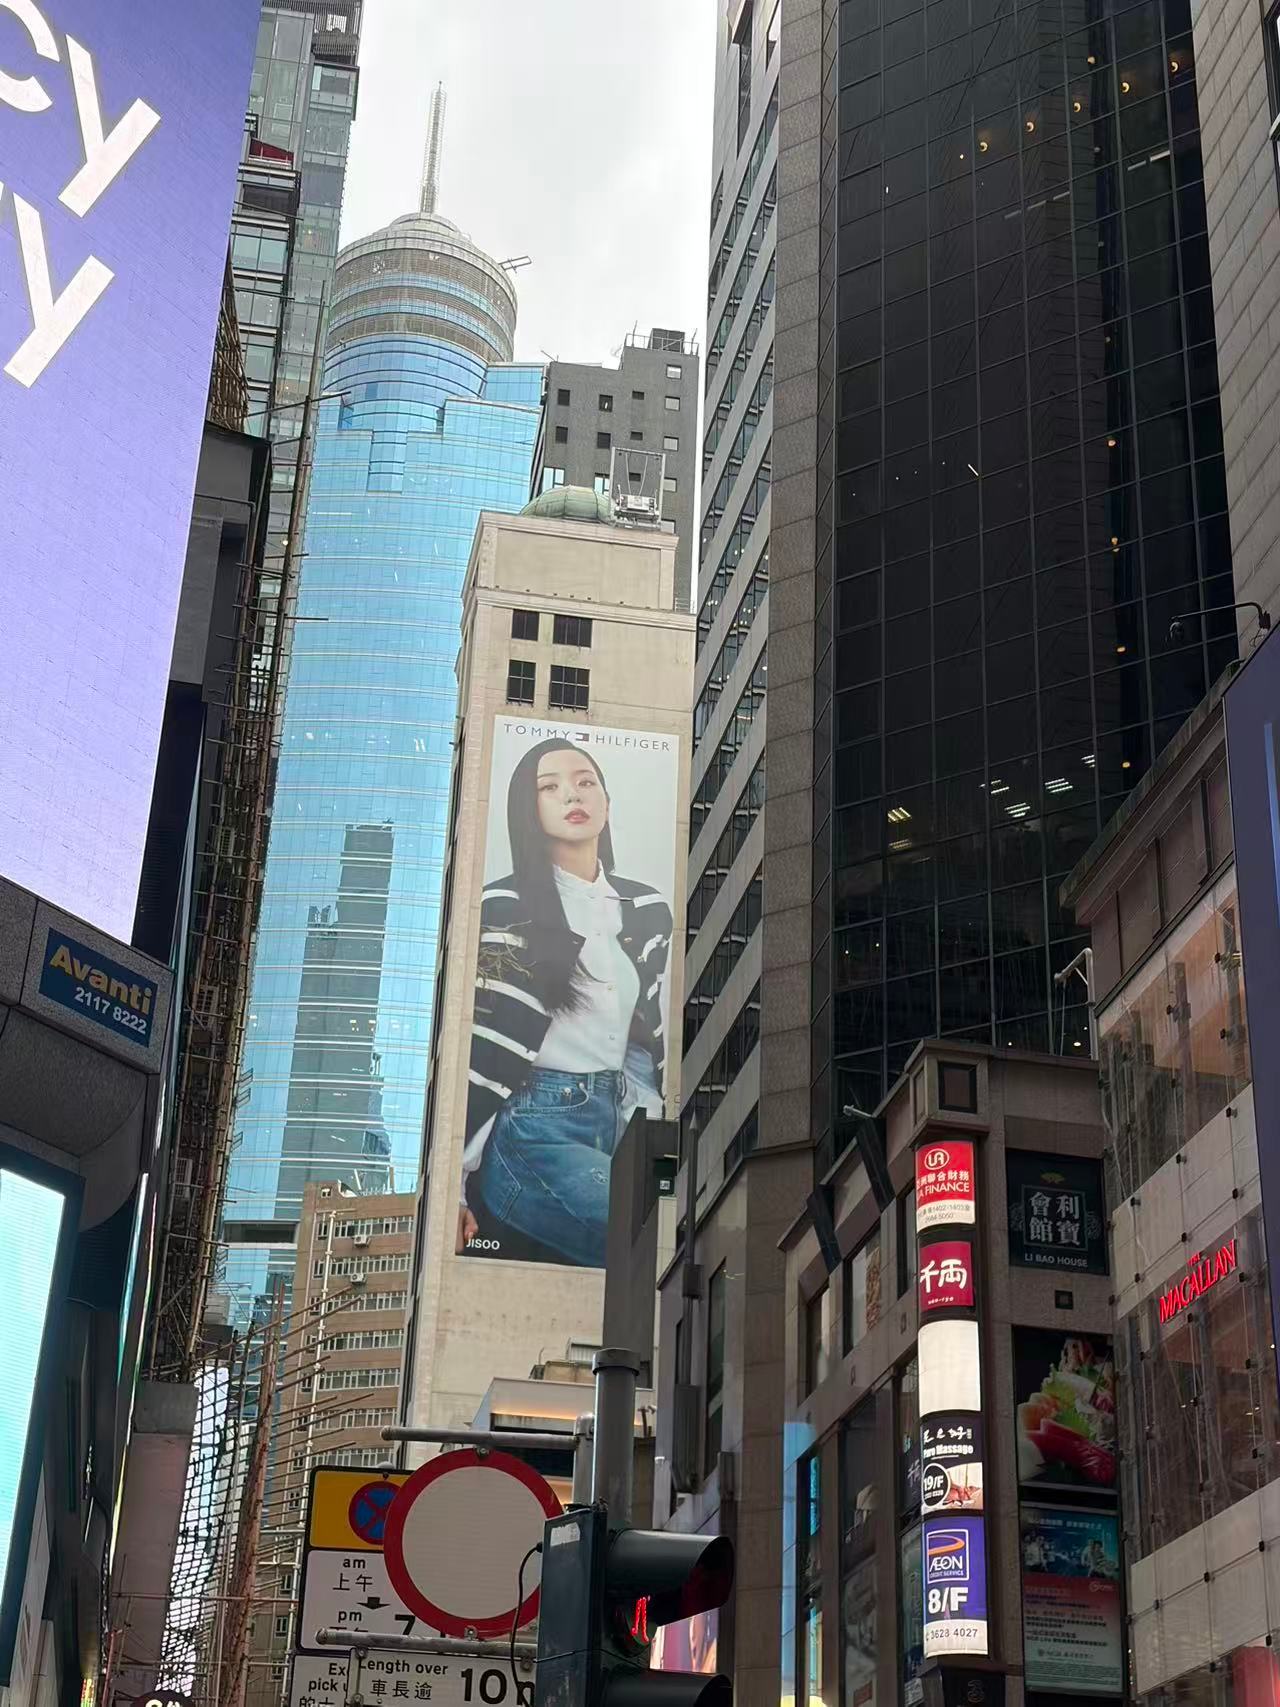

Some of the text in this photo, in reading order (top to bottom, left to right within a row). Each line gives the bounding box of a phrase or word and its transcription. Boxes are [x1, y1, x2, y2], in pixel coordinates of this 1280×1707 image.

[504, 724, 670, 751] TOMMY HILFIGER
[50, 945, 153, 1015] Avanti
[74, 987, 147, 1034] 2117 8222
[925, 1182, 970, 1196] FINANCE
[466, 1238, 500, 1250] JISOO
[1025, 1253, 1088, 1267] LI BAO HOUSE
[1159, 1239, 1237, 1324] MACALLAN
[936, 1444, 974, 1455] Massage
[924, 1475, 944, 1492] 19/F
[343, 1558, 366, 1569] am
[332, 1573, 373, 1593] 上午
[928, 1587, 969, 1614] 8/F
[338, 1611, 362, 1623] pm
[953, 1628, 978, 1638] 4027
[415, 1663, 448, 1675] over
[308, 1677, 338, 1693] pick
[370, 1679, 432, 1700] 車長逾
